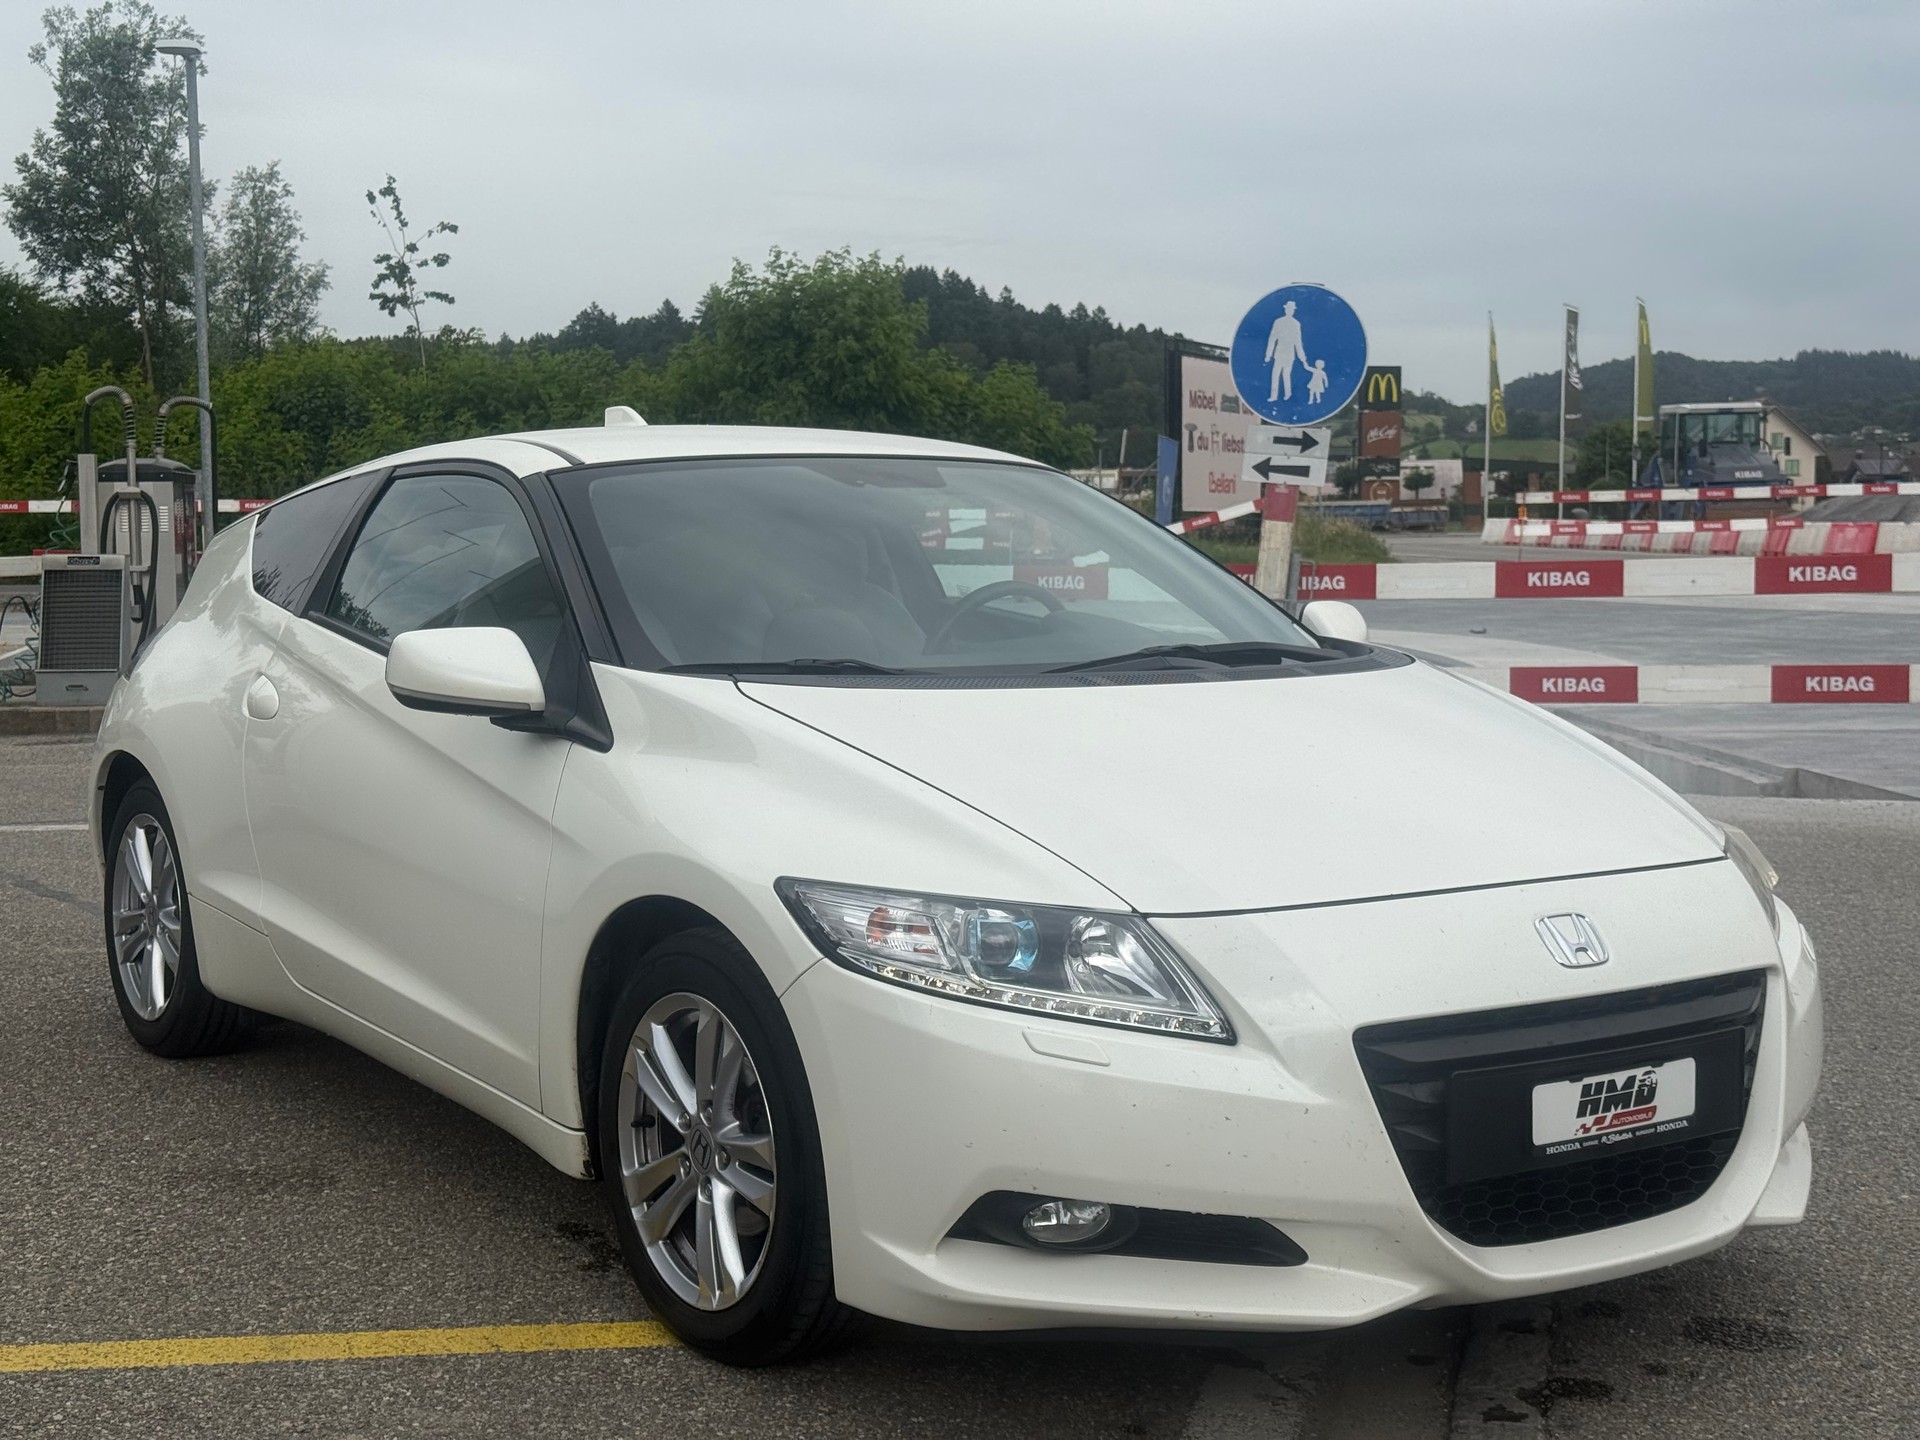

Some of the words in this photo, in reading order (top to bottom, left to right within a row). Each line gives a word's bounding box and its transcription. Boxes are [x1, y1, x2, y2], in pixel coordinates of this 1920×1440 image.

[1527, 571, 1590, 587] KIBAG
[1788, 566, 1857, 582] KIBAG
[1038, 575, 1085, 590] KIBAG
[1298, 575, 1345, 590] IBAG
[1542, 678, 1605, 692] KIBAG
[1805, 676, 1874, 692] KIBAG
[1611, 1111, 1654, 1126] AUTOMOBILE
[1546, 1142, 1582, 1155] HONDA
[1656, 1120, 1688, 1133] HONDA
